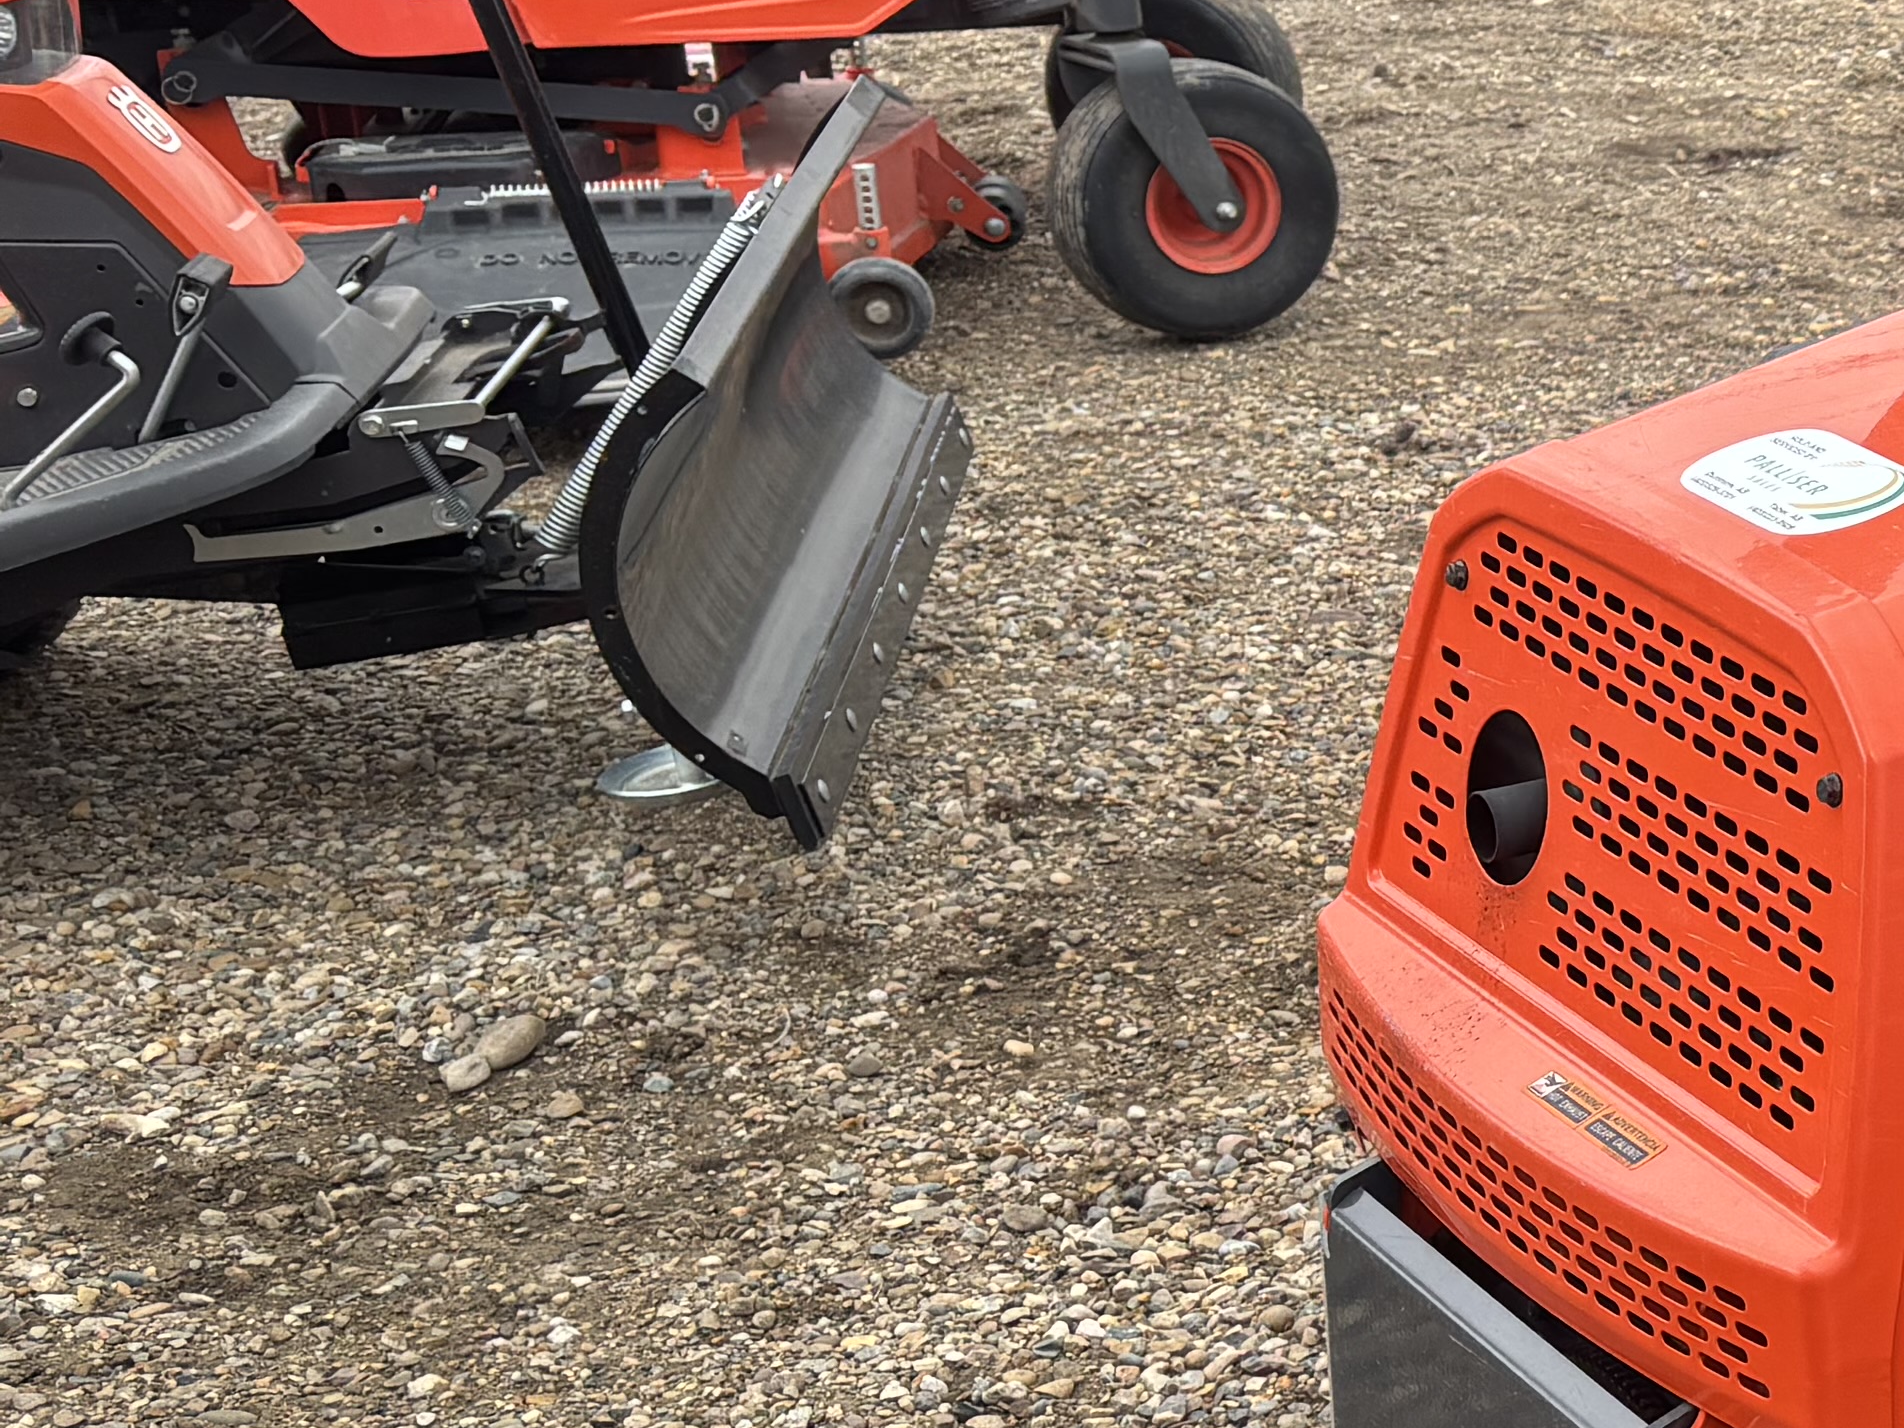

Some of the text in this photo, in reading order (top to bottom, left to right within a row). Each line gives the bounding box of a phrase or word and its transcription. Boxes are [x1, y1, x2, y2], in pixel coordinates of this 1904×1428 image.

[479, 252, 521, 266] DO
[538, 251, 579, 266] NO
[1744, 454, 1829, 496] PALLISER
[1571, 1085, 1604, 1111] WARNING
